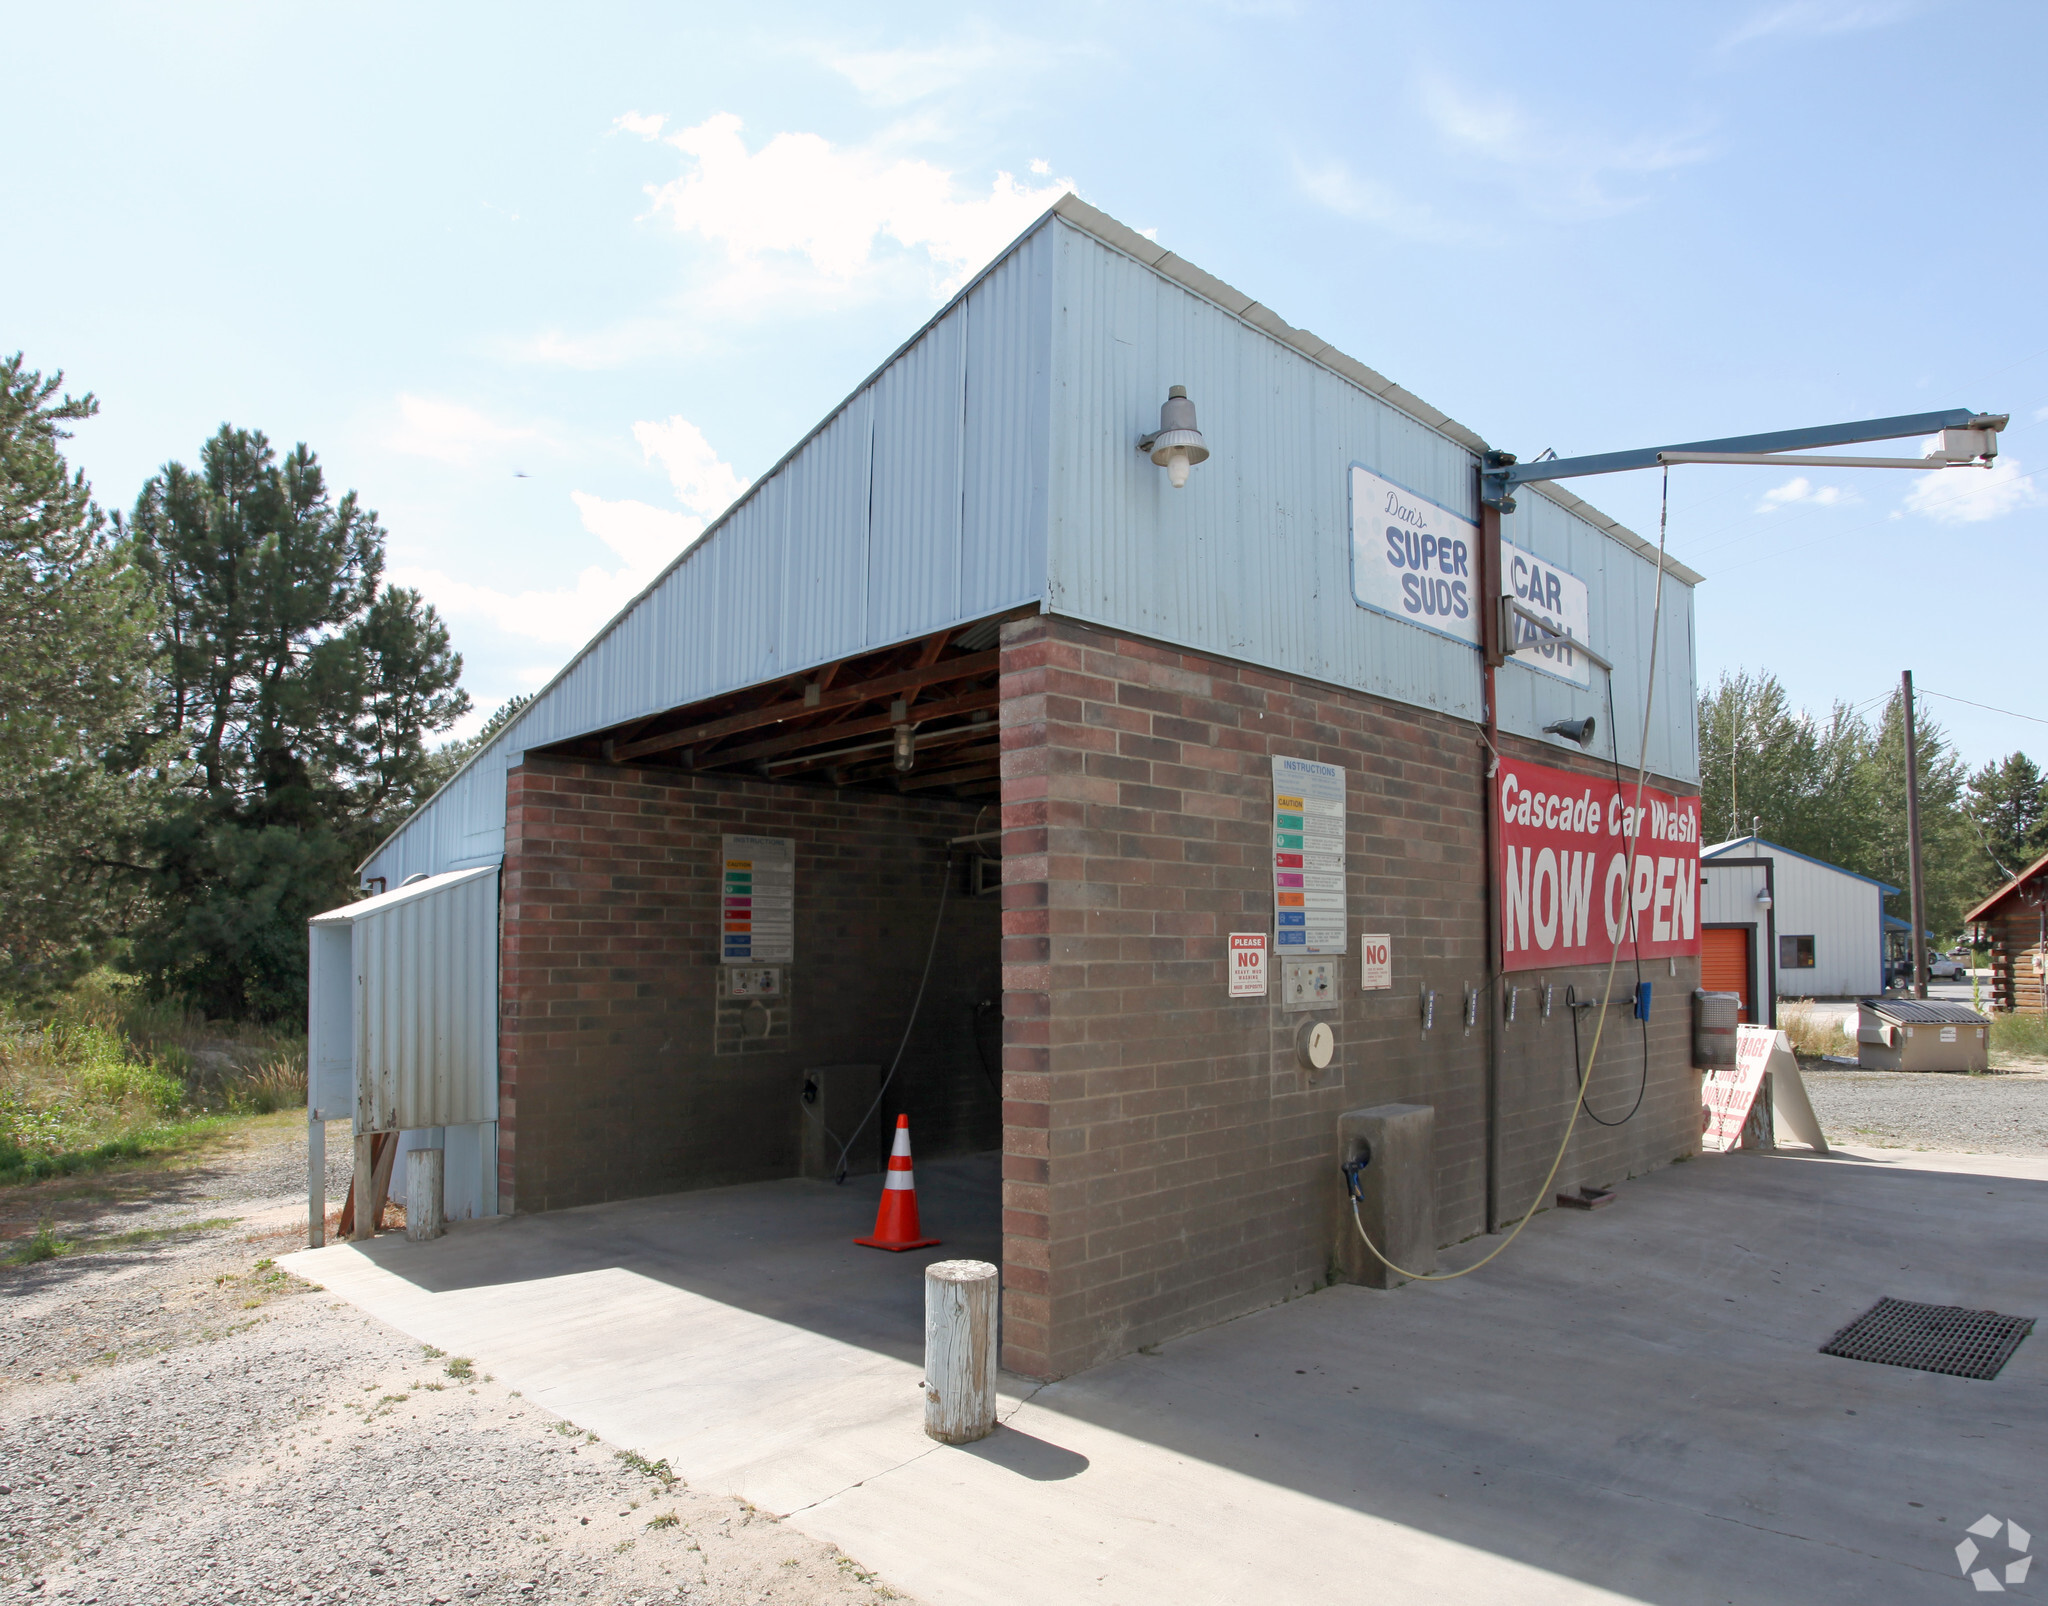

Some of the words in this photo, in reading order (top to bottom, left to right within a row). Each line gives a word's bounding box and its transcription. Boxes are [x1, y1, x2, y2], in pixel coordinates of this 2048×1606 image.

[1385, 491, 1427, 528] Dan's
[1386, 525, 1468, 577] SUPER
[1402, 573, 1469, 619] SUDS
[1511, 555, 1562, 615] CAR
[1284, 760, 1336, 777] INSTRUCTIONS
[1278, 798, 1303, 809] CAUTION
[1502, 773, 1601, 834] Cascade
[1608, 793, 1647, 837] Car
[1650, 799, 1696, 843] Wash
[733, 837, 785, 846] INSTRUCTIONS
[1506, 845, 1596, 952] NOW
[1604, 852, 1696, 945] OPEN
[1235, 938, 1262, 946] PLEASE
[1366, 945, 1387, 965] NO
[1238, 952, 1260, 967] NO
